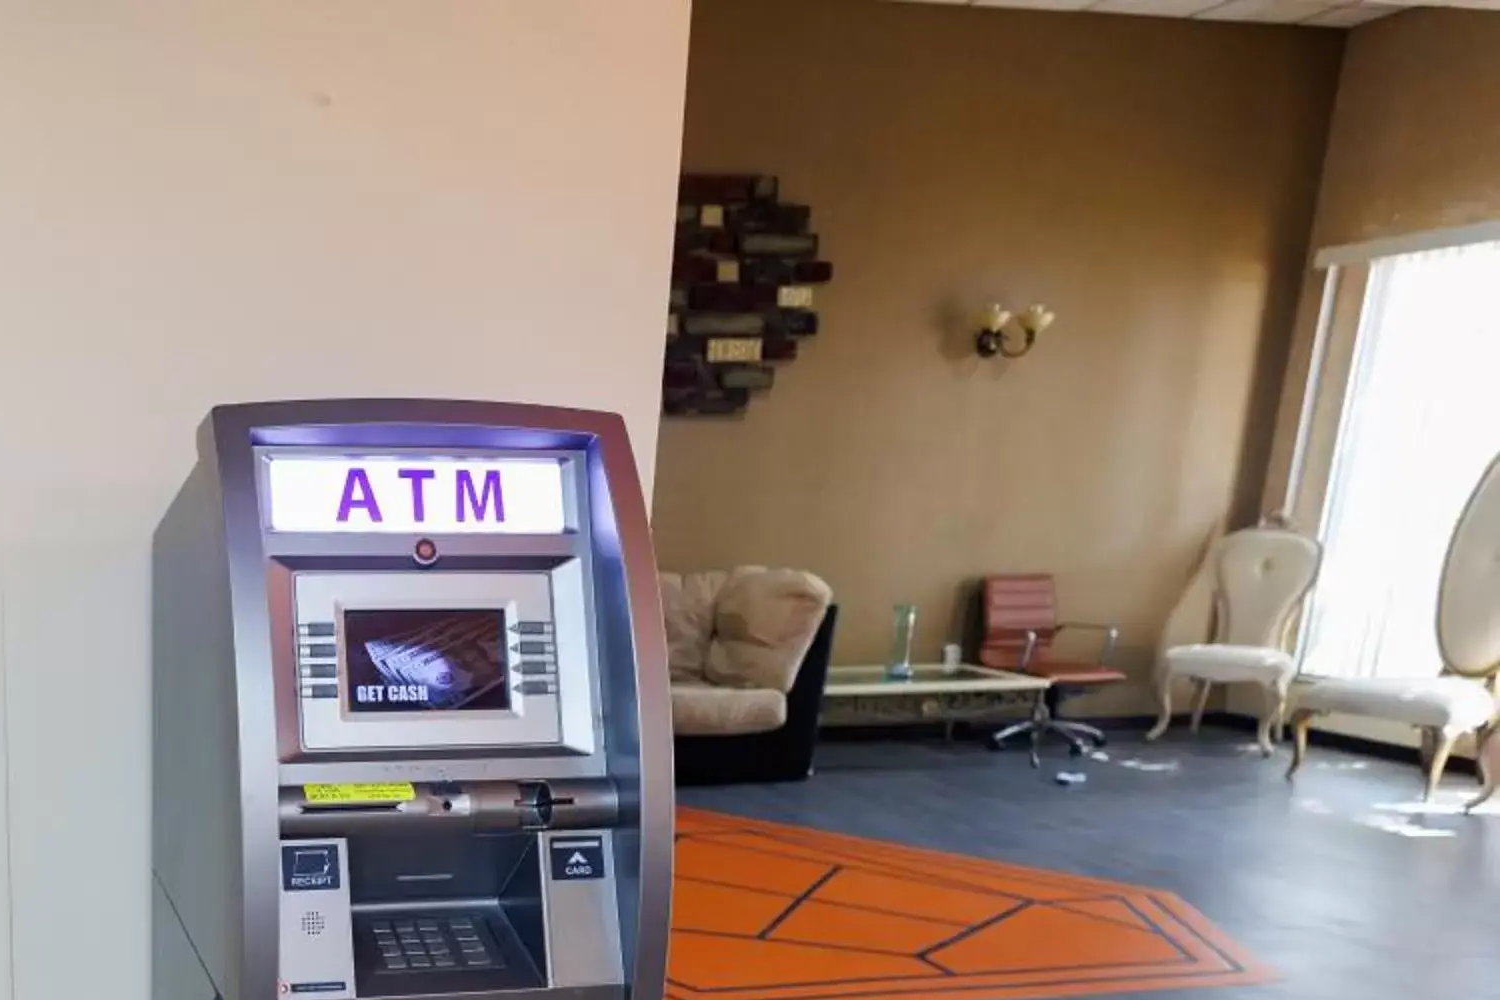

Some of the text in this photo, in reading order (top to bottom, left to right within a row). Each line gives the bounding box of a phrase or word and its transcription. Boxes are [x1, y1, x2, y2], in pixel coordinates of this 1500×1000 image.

[336, 468, 505, 522] ATM
[357, 685, 428, 702] GET CASH
[565, 865, 592, 876] CARD
[291, 876, 331, 886] RECEIPT
